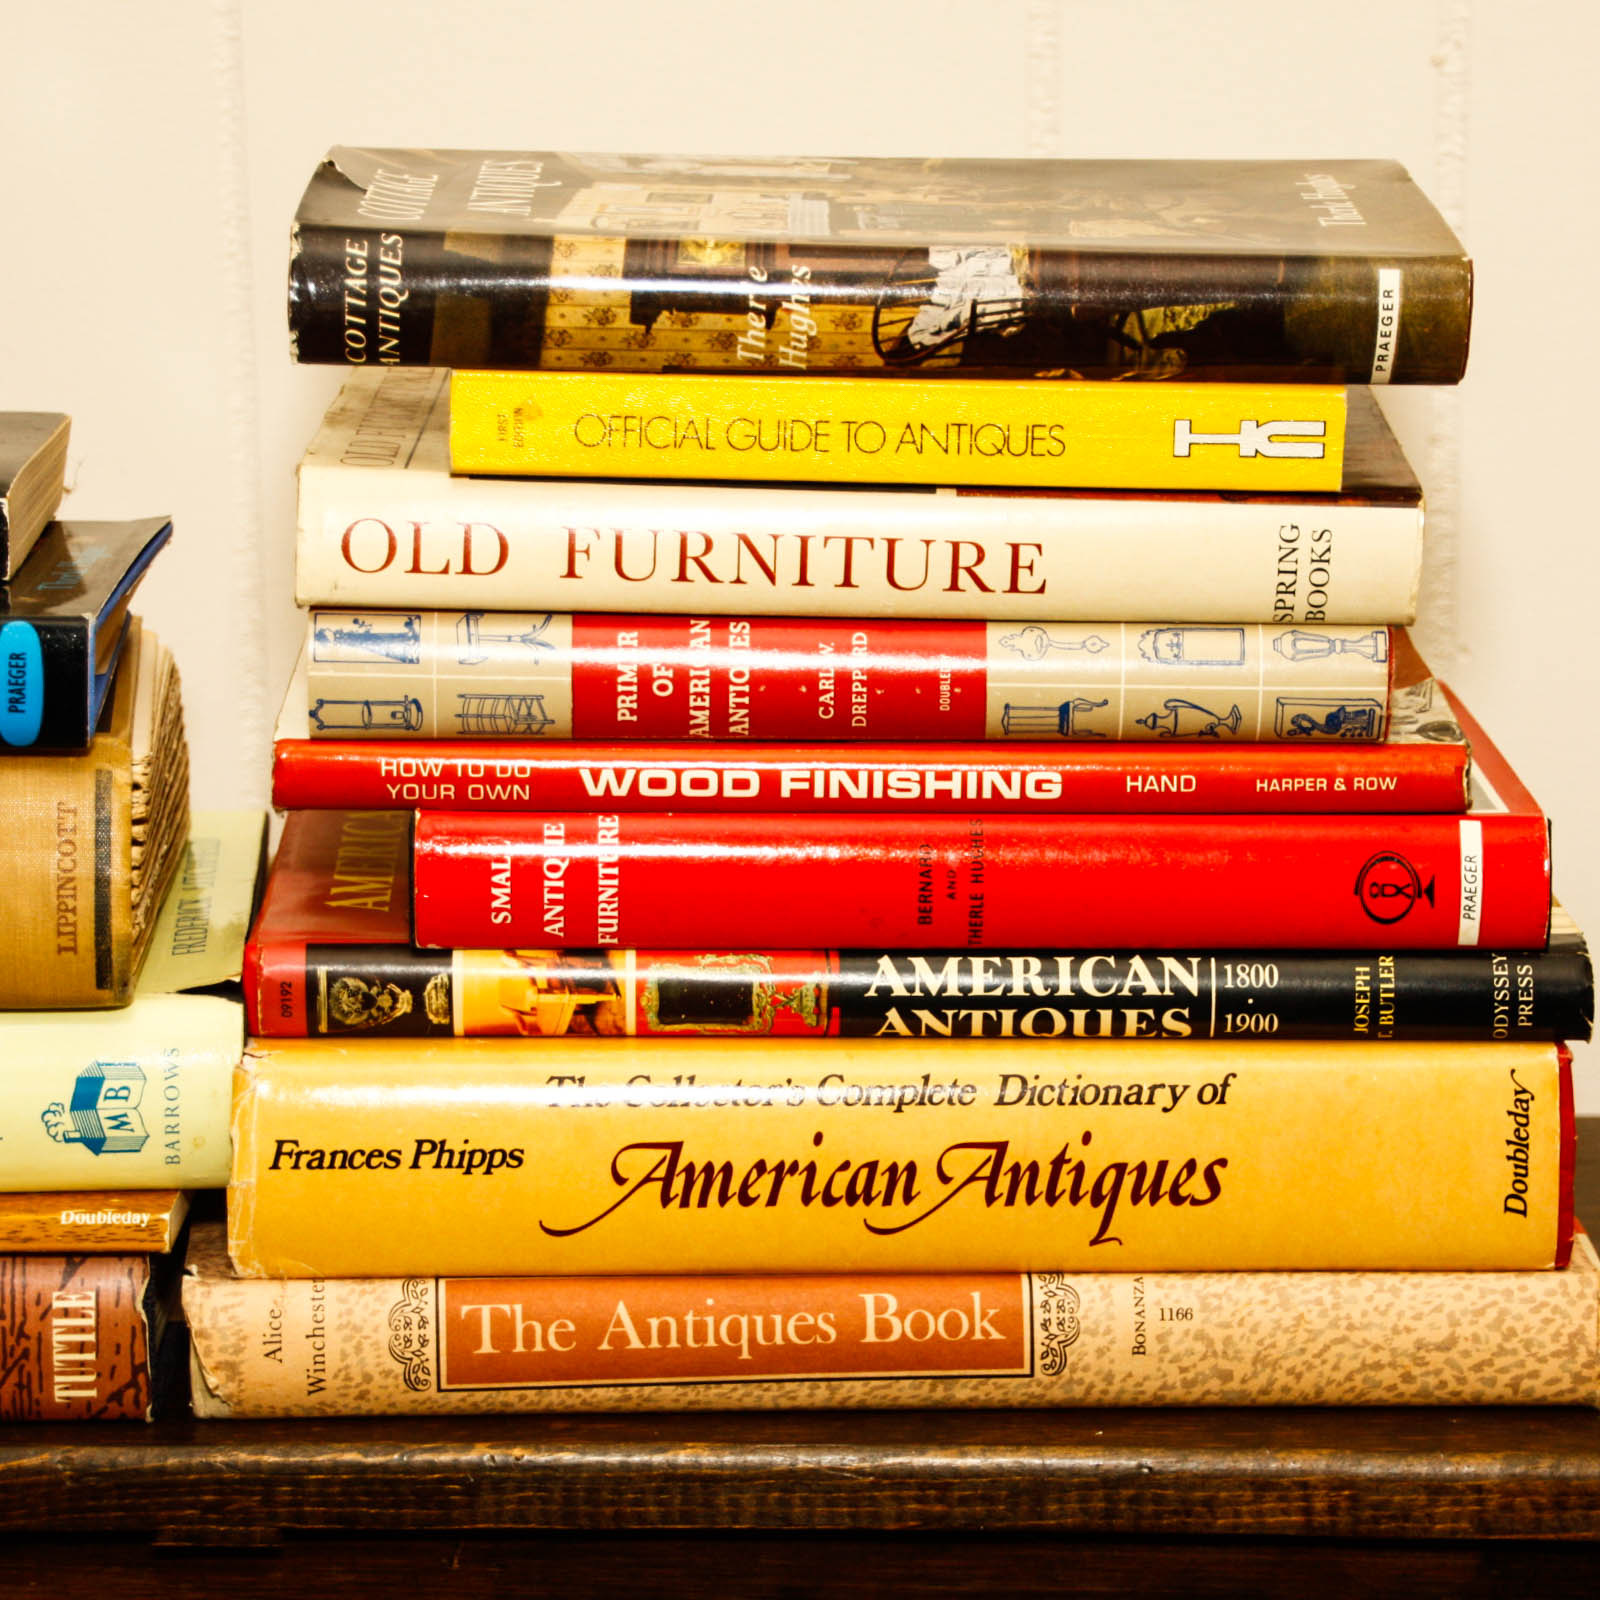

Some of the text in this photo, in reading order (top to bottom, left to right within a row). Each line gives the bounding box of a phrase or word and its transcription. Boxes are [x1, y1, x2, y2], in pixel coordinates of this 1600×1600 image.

[344, 239, 369, 365] COTTAGE
[736, 265, 768, 360] There
[1375, 288, 1394, 373] PRAEGER
[573, 414, 1066, 458] OFFICIAL GUIDE TO ANTIQUES
[341, 518, 1047, 595] OLD FURNITURE
[1273, 523, 1300, 623] SPRING
[1304, 528, 1333, 623] BOOKS
[8, 651, 26, 713] PRAEGER
[616, 631, 639, 722] PRIMR
[689, 619, 711, 738] AMERIAN
[729, 621, 751, 736] ANTIQES
[818, 667, 835, 720] CARL
[851, 632, 868, 728] DREPPRD
[381, 758, 531, 778] HOW TO DO
[386, 784, 530, 800] YOUR OWN
[579, 769, 1063, 799] WOOD FINISHING
[1126, 775, 1197, 793] HAND
[1256, 776, 1398, 793] HARPER & ROW
[57, 802, 78, 955] LIPPINCOTT
[490, 842, 512, 924] SMAL
[543, 823, 570, 937] ANTIQE
[917, 844, 934, 926] BERNARD
[967, 818, 985, 946] THERLE HUGHES
[1462, 854, 1477, 921] PRAEGER
[864, 954, 1202, 998] AMERICAN
[1223, 963, 1279, 989] 1800
[1353, 966, 1371, 1034] JOSEPH
[1379, 955, 1395, 1026] BUTLER
[1492, 953, 1511, 1040] ODYSSEY
[1517, 965, 1533, 1027] PRESS
[874, 1007, 1192, 1038] ANTIQUES
[1223, 1013, 1279, 1034] 1900
[164, 1048, 181, 1166] BARROWS
[817, 1074, 977, 1112] Complete
[993, 1073, 1191, 1113] Dictionary
[1196, 1072, 1237, 1106] of
[268, 1138, 525, 1176] Frances Phipps
[1504, 1068, 1535, 1218] Doubleday
[60, 1210, 151, 1228] Doubleday
[538, 1130, 1229, 1248] American Antiques
[52, 1290, 98, 1403] TUTTLE
[262, 1308, 284, 1364] Alice
[460, 1291, 1008, 1361] The Antiques Book
[1158, 1307, 1194, 1322] 1166
